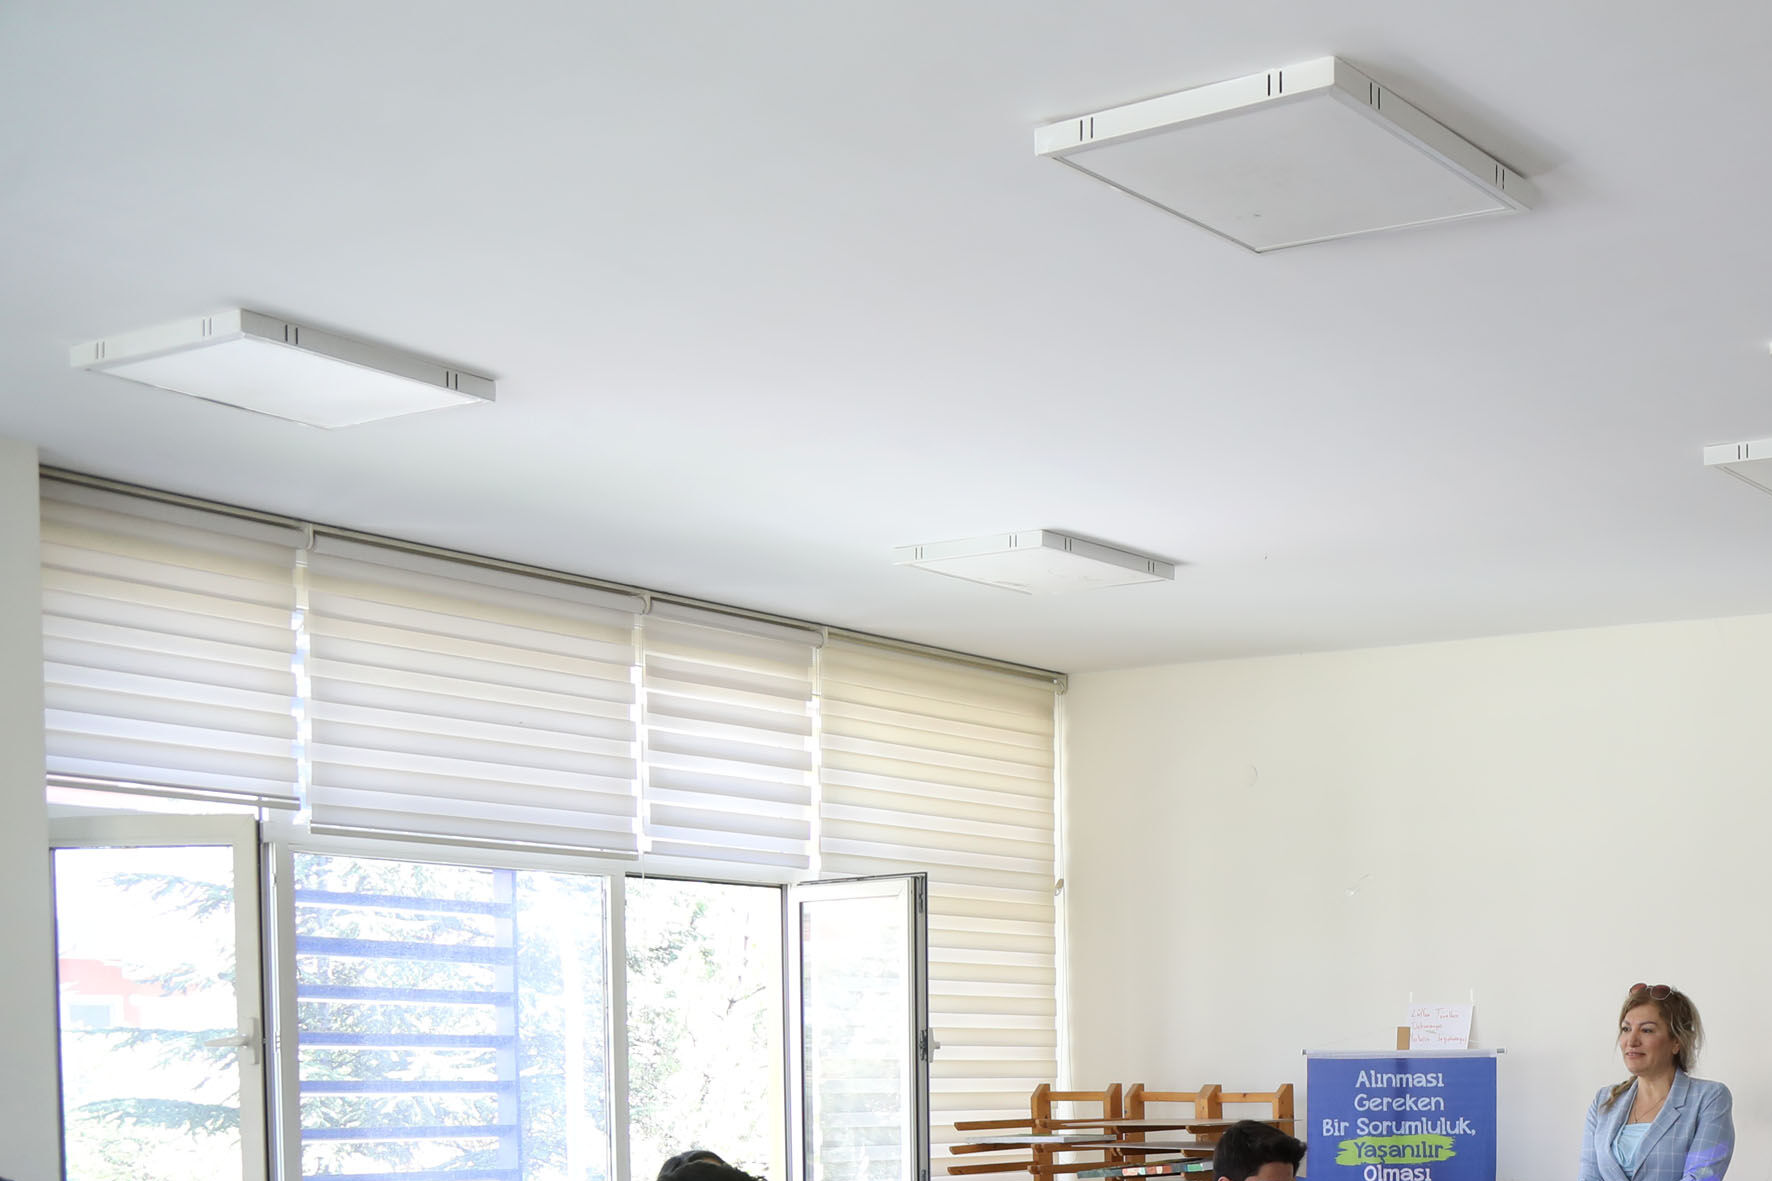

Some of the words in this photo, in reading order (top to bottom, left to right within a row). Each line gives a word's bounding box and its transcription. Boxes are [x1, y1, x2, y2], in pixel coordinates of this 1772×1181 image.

[1356, 1070, 1444, 1087] Alınması
[1354, 1094, 1444, 1111] Gereken
[1323, 1119, 1349, 1136] Bir
[1357, 1117, 1475, 1137] Sorumluluk,
[1355, 1141, 1444, 1163] Yaşanılır
[1364, 1165, 1431, 1181] Olması
